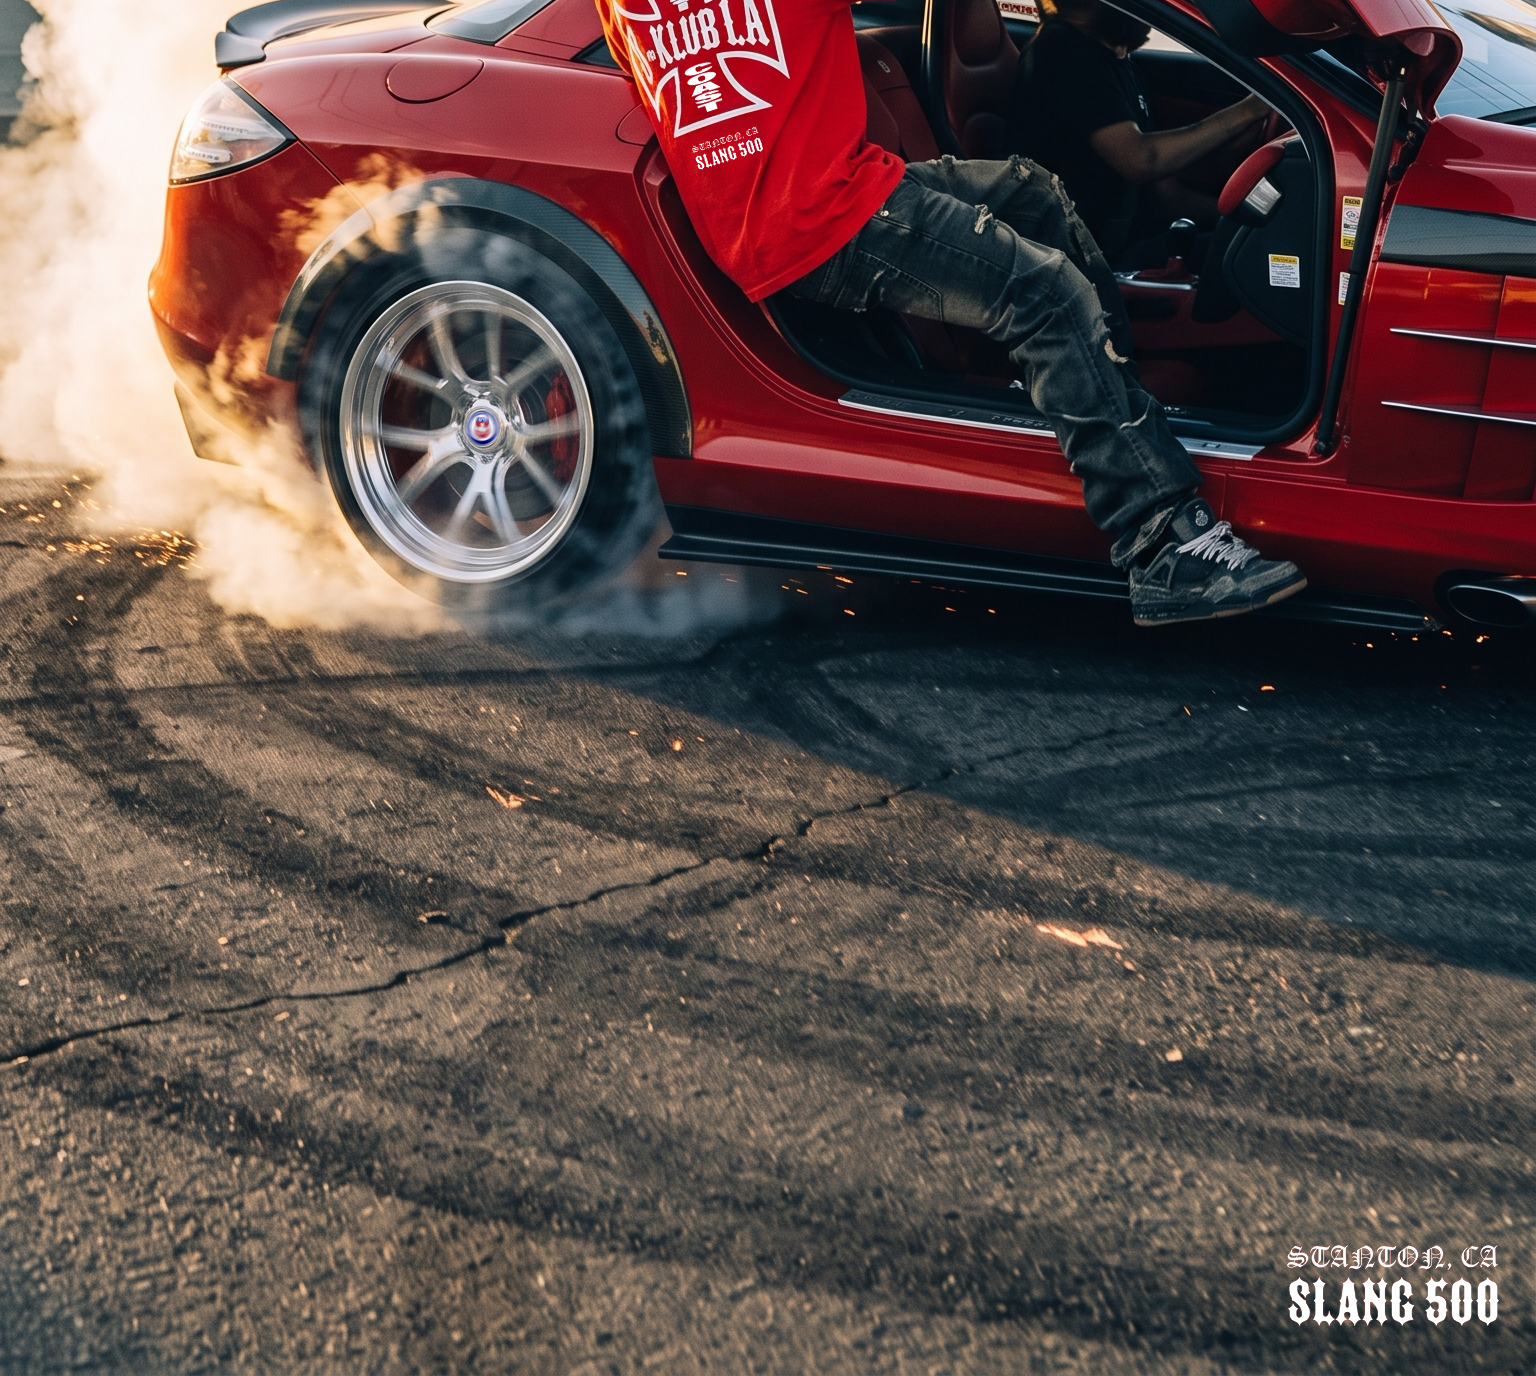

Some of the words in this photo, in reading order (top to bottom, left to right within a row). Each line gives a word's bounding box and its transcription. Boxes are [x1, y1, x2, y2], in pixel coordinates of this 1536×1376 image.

[649, 7, 720, 70] KLUB
[684, 62, 723, 113] COAST
[695, 145, 738, 170] SLANG
[737, 137, 764, 157] 500
